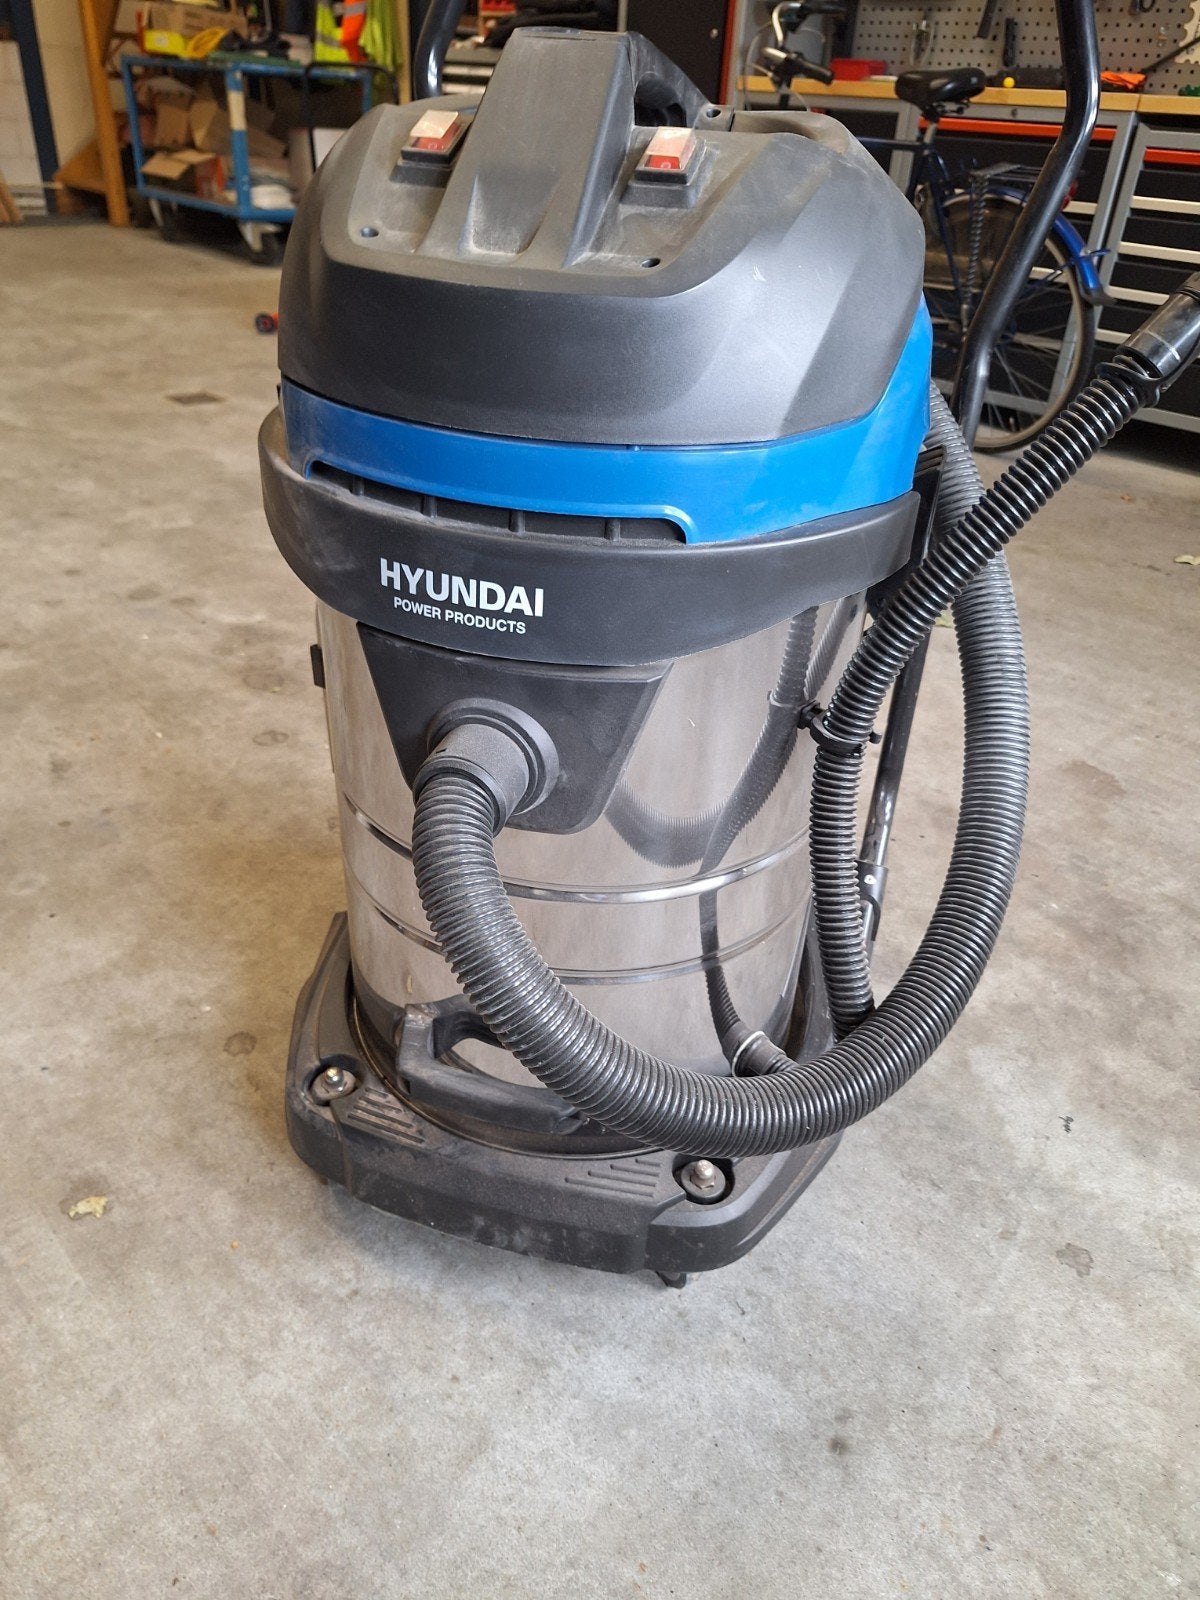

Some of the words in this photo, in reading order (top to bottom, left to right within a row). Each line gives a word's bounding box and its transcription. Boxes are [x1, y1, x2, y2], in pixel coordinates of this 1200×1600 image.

[380, 557, 544, 617] HYUNDAI
[393, 597, 442, 620] POWER
[445, 609, 527, 635] PRODUCTS
